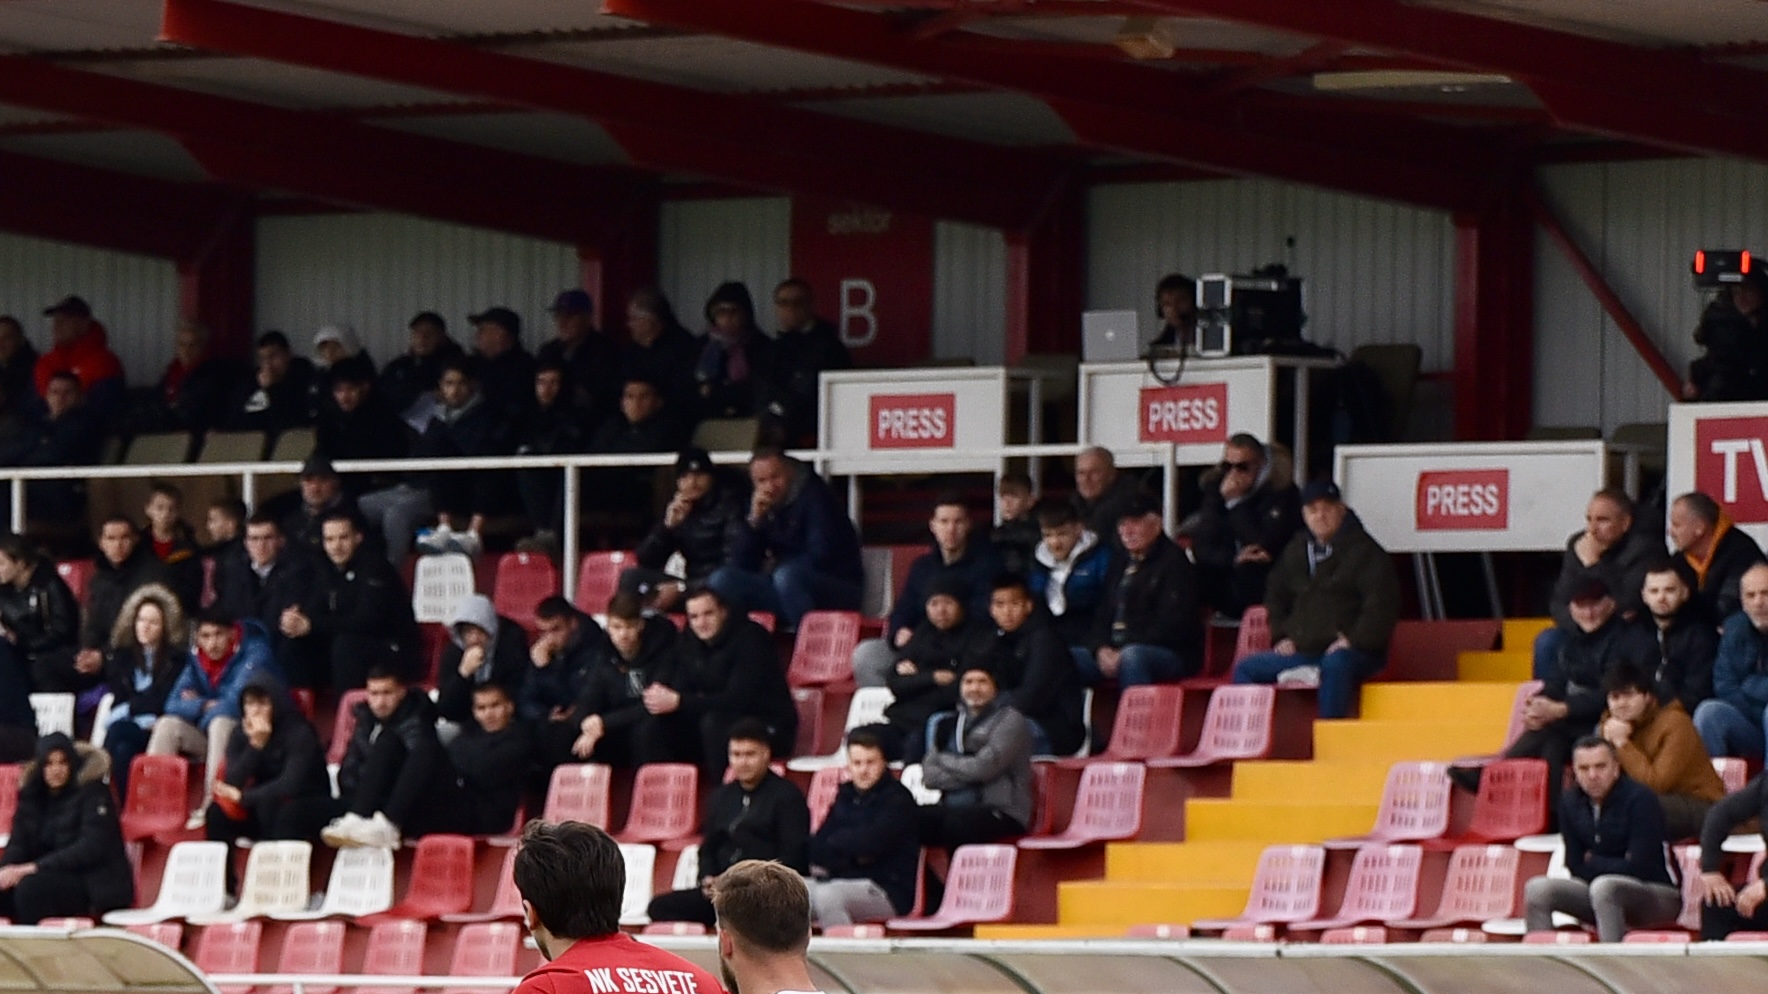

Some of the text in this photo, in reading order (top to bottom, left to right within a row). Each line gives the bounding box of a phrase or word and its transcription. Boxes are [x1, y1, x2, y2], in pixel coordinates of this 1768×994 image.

[840, 268, 877, 348] B
[877, 407, 947, 439] PRESS
[1147, 397, 1219, 432] PRESS
[1426, 483, 1499, 516] PRESS
[584, 967, 620, 994] NK
